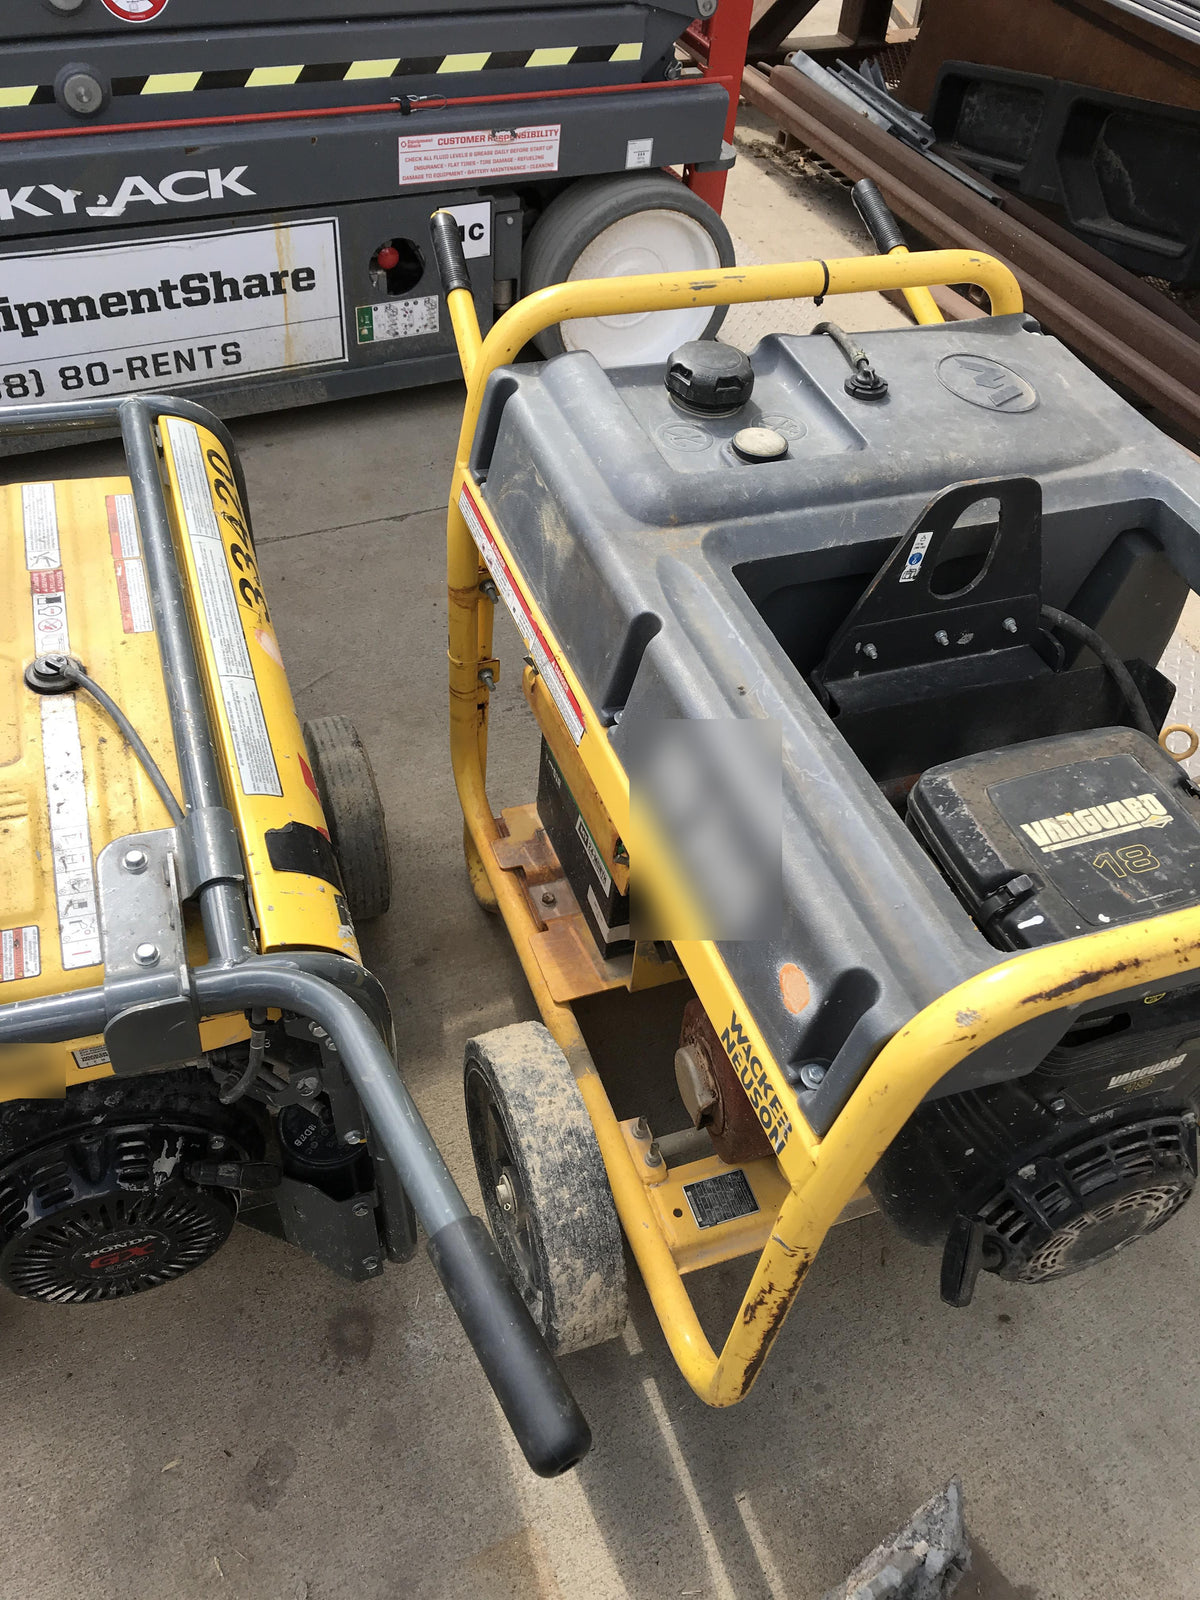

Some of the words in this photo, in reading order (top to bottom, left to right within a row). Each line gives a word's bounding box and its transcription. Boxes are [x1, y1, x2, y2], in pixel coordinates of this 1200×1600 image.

[438, 133, 486, 146] CUSTOMER
[488, 129, 559, 142] RSPNSIBILITY
[433, 170, 464, 178] EQUIPMENT
[0, 369, 45, 399] 8)
[58, 342, 242, 391] 80-RENTS
[1020, 793, 1168, 847] VANGUARD
[1093, 844, 1160, 878] 18
[720, 1026, 786, 1155] NEUSON
[731, 1010, 792, 1142] WACKER
[82, 1235, 158, 1258] HONDA
[90, 1242, 155, 1269] GX
